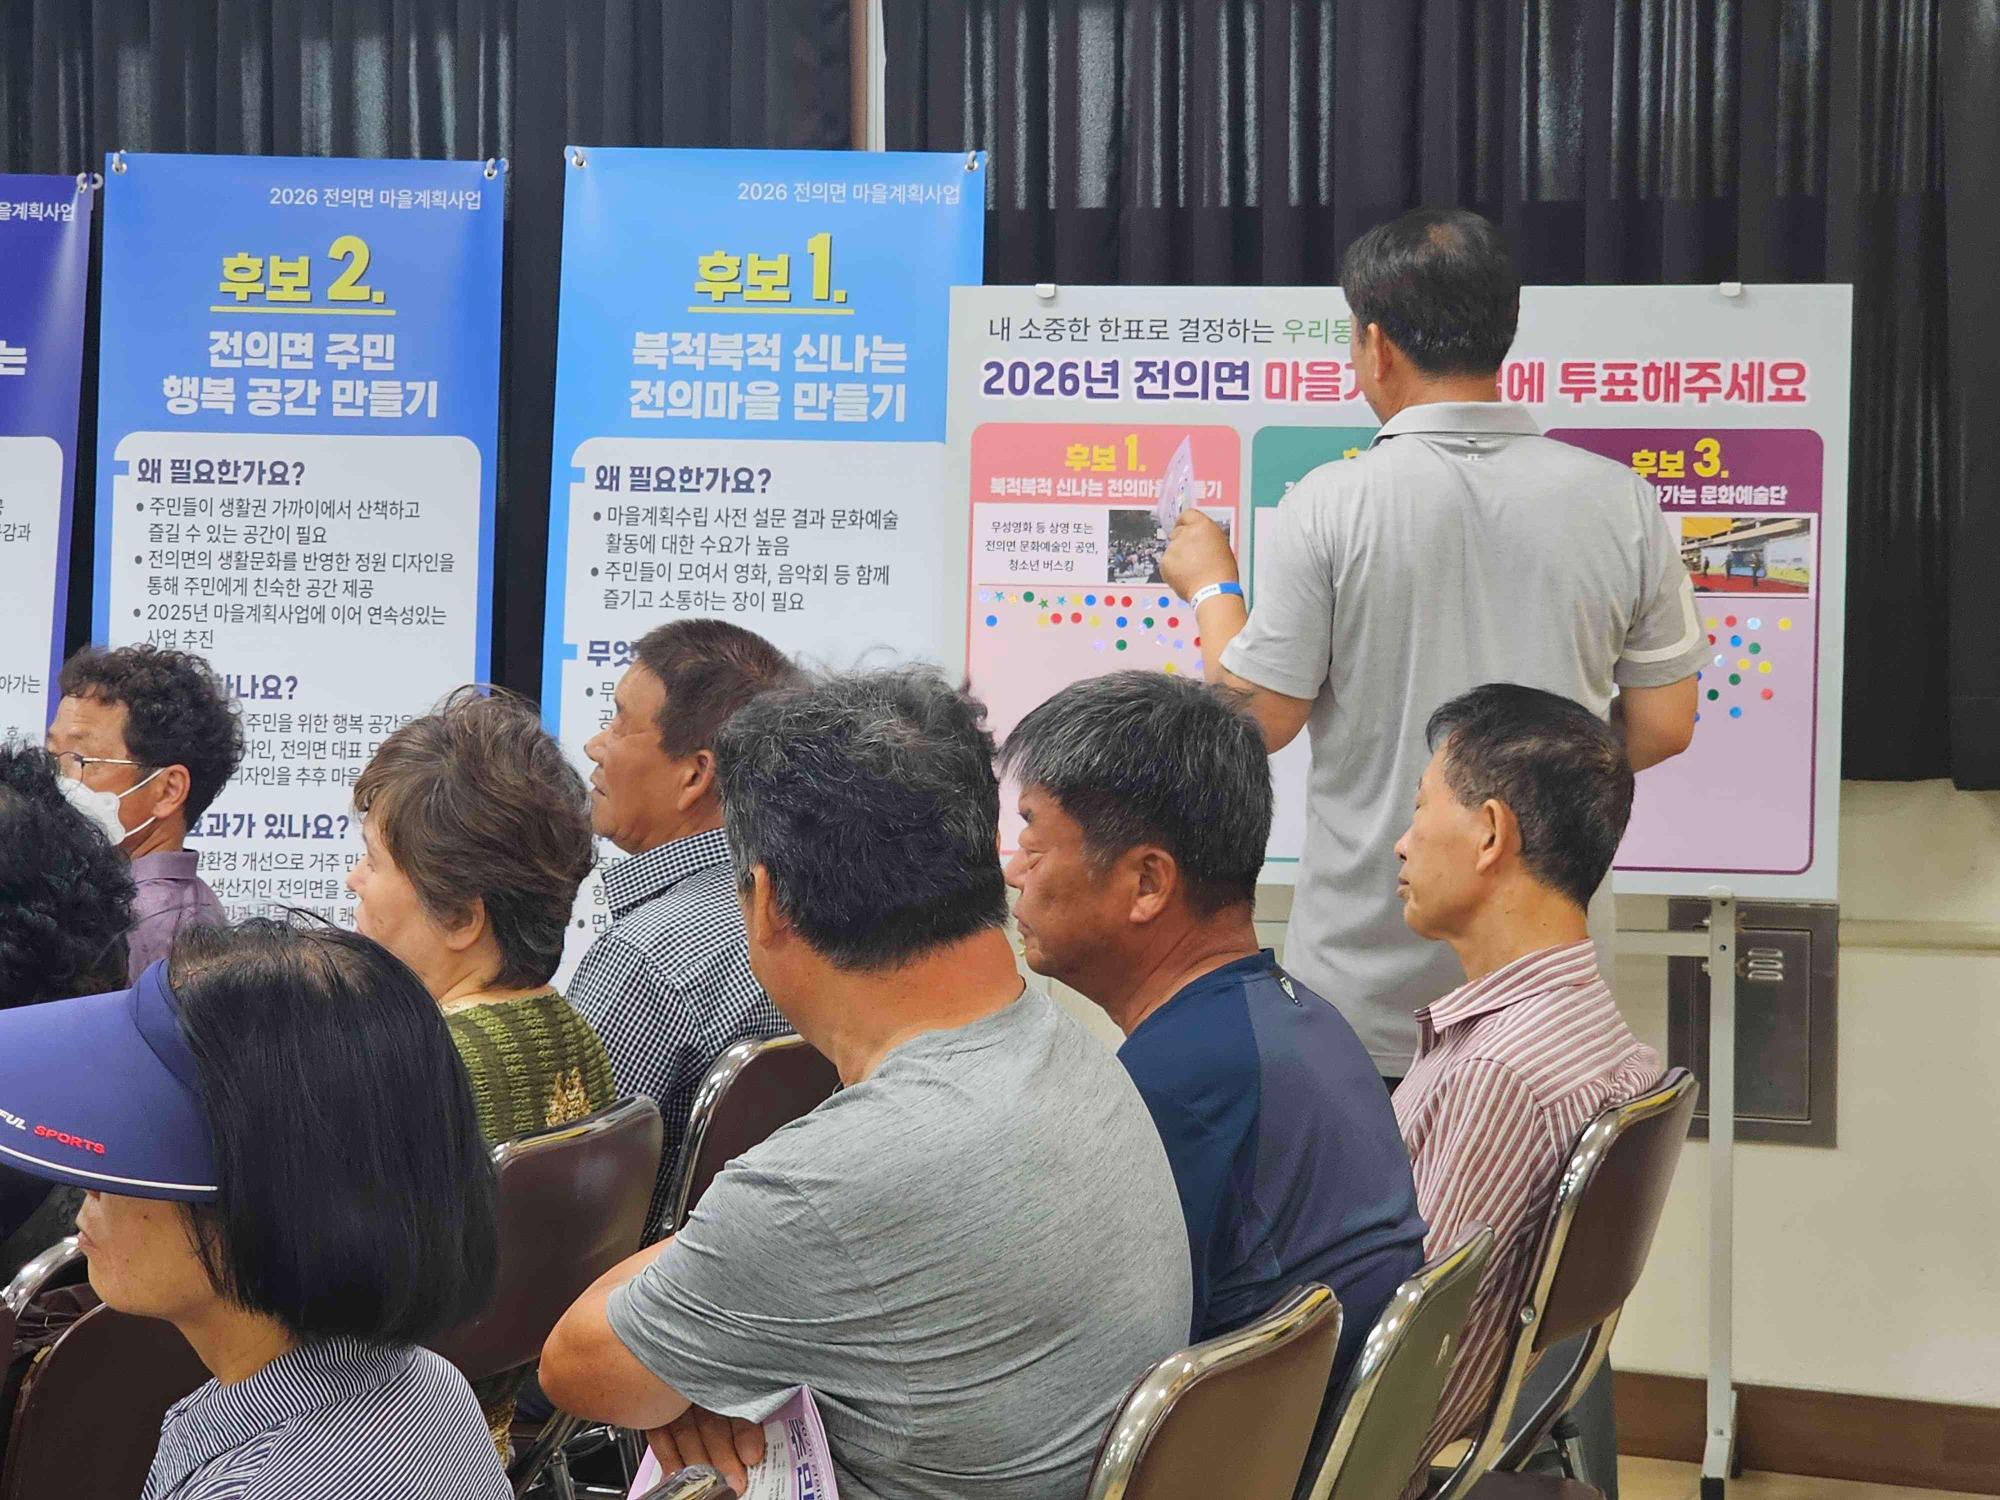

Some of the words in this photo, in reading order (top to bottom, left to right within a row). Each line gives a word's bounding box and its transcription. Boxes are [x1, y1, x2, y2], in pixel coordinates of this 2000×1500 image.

[270, 188, 318, 205] 2026
[323, 189, 374, 208] 전의면
[380, 191, 482, 209] 마을계획사업
[737, 184, 787, 201] 2026
[794, 183, 847, 203] 전의면
[853, 184, 960, 205] 마을계획사업
[218, 252, 311, 302] 후보
[327, 235, 385, 303] 2.
[694, 250, 791, 303] 후보
[806, 233, 848, 303] 1.
[989, 318, 1010, 341] 내
[1019, 317, 1090, 342] 소중한
[1099, 317, 1169, 343] 한표로
[1179, 318, 1275, 344] 결정하는
[208, 331, 314, 369] 전의면
[325, 334, 395, 371] 주민
[631, 332, 782, 371] 북적북적
[793, 334, 907, 373] 신나는
[983, 360, 1120, 400] 2026년
[1134, 360, 1250, 400] 전의면
[1496, 362, 1544, 403] 에
[1559, 361, 1806, 403] 투표해주세요
[163, 375, 236, 415] 행복
[246, 378, 321, 416] 공간
[332, 381, 438, 418] 만들기
[629, 380, 781, 420] 전의마을
[793, 383, 905, 423] 만들기
[1065, 443, 1116, 471] 후보
[1124, 435, 1147, 471] 1.
[1631, 450, 1684, 478] 후보
[1693, 438, 1729, 479] 3.
[137, 459, 161, 485] 왜
[169, 458, 305, 486] 필요한가요?
[595, 467, 620, 492] 왜
[628, 466, 771, 494] 필요한가요?
[990, 475, 1052, 496] 북적북적
[1057, 476, 1103, 497] 신나는
[1700, 485, 1787, 506] 문화예술단
[149, 498, 213, 517] 주민들이
[219, 498, 266, 518] 생활권
[272, 498, 351, 520] 가까이에서
[357, 500, 420, 520] 산책하고
[607, 507, 707, 527] 마을계획수립
[714, 507, 748, 528] 사전
[753, 508, 786, 528] 설문
[792, 509, 826, 529] 결과
[830, 509, 899, 530] 문화예술
[0, 523, 31, 542] 감과
[148, 523, 180, 542] 즐길
[185, 524, 202, 543] 수
[207, 524, 238, 544] 있는
[243, 524, 291, 545] 공간이
[296, 525, 327, 545] 필요
[992, 522, 1032, 534] 무성영화
[1036, 523, 1046, 534] 등
[1050, 523, 1069, 534] 상영
[1073, 523, 1093, 535] 또는
[605, 534, 656, 555] 활동에
[662, 535, 695, 555] 대한
[700, 536, 751, 556] 수요가
[756, 536, 789, 556] 높음
[985, 541, 1016, 552] 전의면
[1020, 542, 1071, 553] 문화예술인
[1075, 543, 1098, 554] 공연,
[148, 551, 212, 570] 전의면의
[217, 551, 297, 571] 생활문화를
[303, 552, 350, 572] 반영한
[356, 553, 387, 573] 정원
[392, 553, 455, 573] 디자인을
[1008, 560, 1040, 571] 청소년
[1043, 561, 1074, 572] 버스킹
[604, 562, 671, 582] 주민들이
[677, 564, 728, 583] 모여서
[734, 564, 772, 587] 영화,
[777, 564, 828, 585] 음악회
[834, 565, 851, 585] 등
[856, 566, 889, 586] 함께
[147, 577, 178, 596] 통해
[184, 577, 247, 598] 주민에게
[253, 578, 301, 598] 친숙한
[307, 579, 338, 598] 공간
[342, 579, 373, 599] 제공
[603, 590, 653, 611] 즐기고
[659, 591, 726, 611] 소통하는
[732, 591, 766, 611] 장이
[771, 592, 804, 612] 필요
[147, 603, 208, 623] 2025년
[214, 604, 326, 625] 마을계획사업에
[332, 605, 362, 625] 이어
[367, 605, 447, 626] 연속성있는
[182, 629, 213, 650] 추진
[246, 713, 292, 733] 주민을
[297, 714, 328, 734] 위한
[333, 714, 363, 734] 행복
[281, 740, 326, 760] 전의면
[332, 741, 362, 760] 대표
[296, 767, 326, 787] 추후
[265, 814, 349, 839] 있나요?
[242, 852, 303, 871] 개선으로
[310, 853, 340, 872] 거주
[276, 879, 340, 899] 전의면을
[34, 1126, 106, 1155] SPORTS
